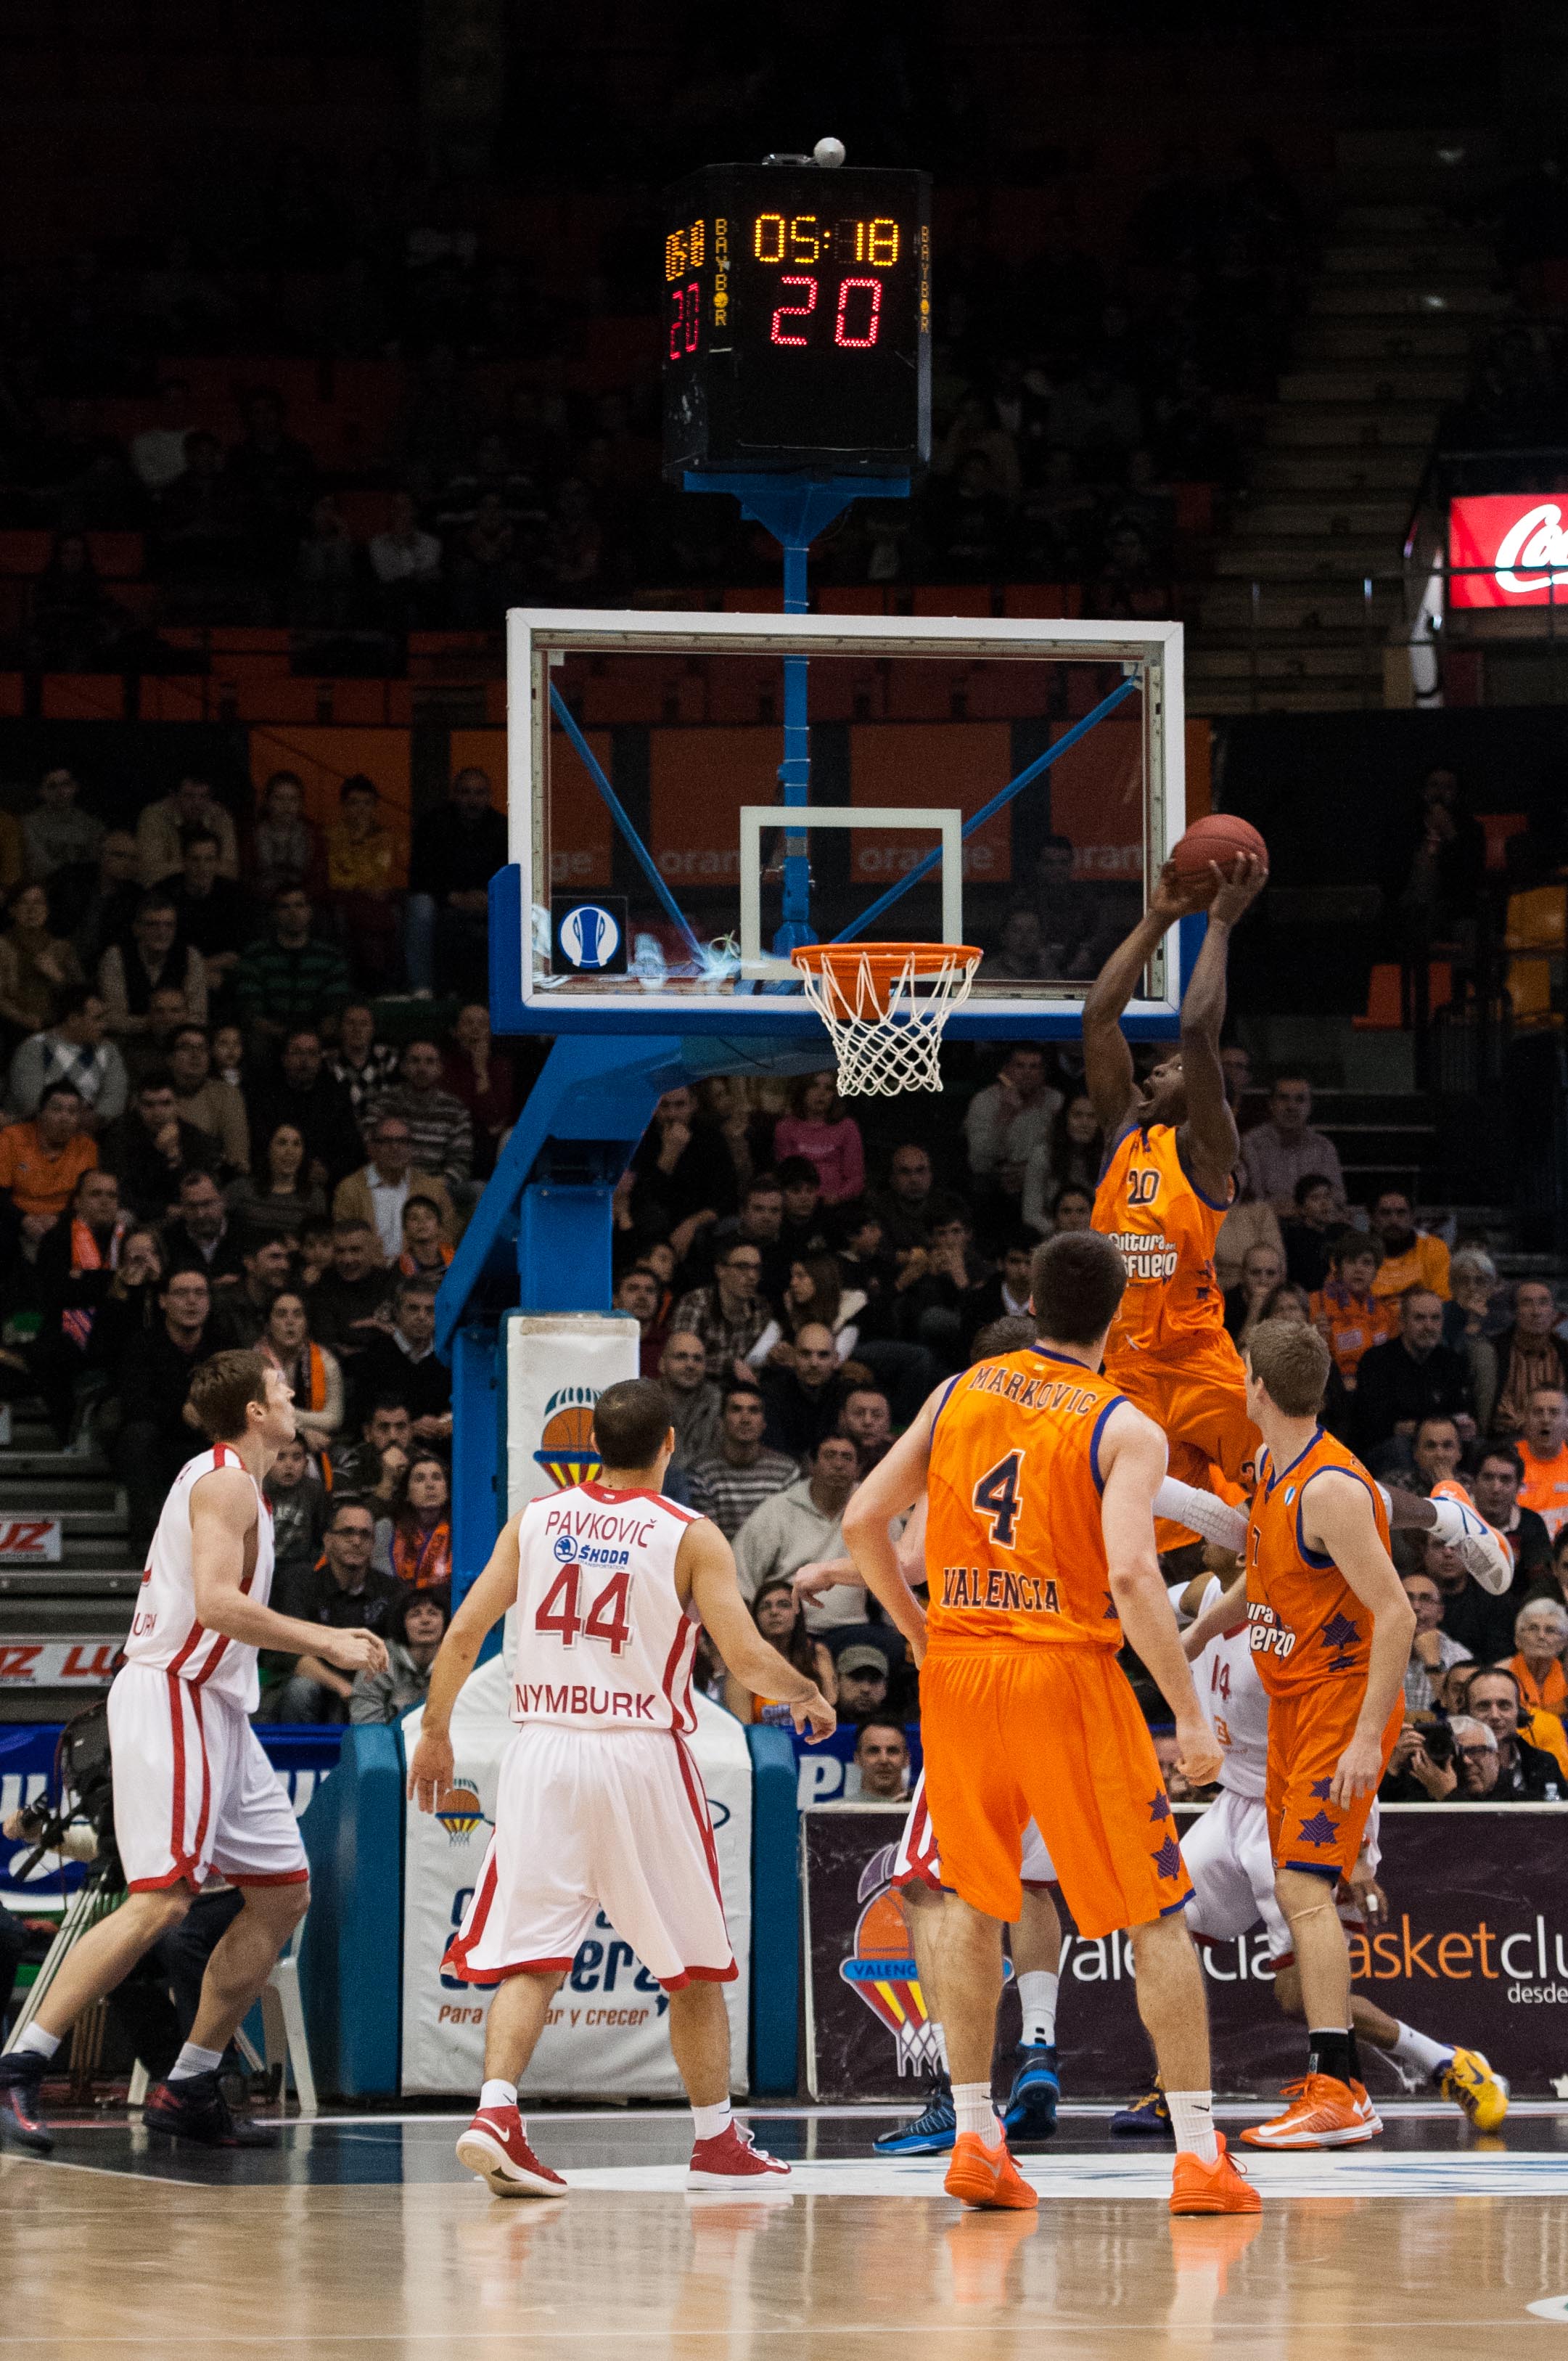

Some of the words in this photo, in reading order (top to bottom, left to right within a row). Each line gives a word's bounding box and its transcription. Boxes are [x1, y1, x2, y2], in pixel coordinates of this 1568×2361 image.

[770, 276, 882, 348] 20
[1126, 1168, 1162, 1208] 20
[968, 1364, 1097, 1415] MARKOVIC
[972, 1448, 1026, 1550] 4
[578, 1544, 629, 1566] ŠKODA
[535, 1563, 631, 1656] 44
[940, 1567, 1061, 1614] VALENCIA
[1210, 1654, 1231, 1701] 14
[514, 1684, 657, 1720] NYMBURK
[1507, 1981, 1568, 2004] desde
[586, 2008, 649, 2026] crecer
